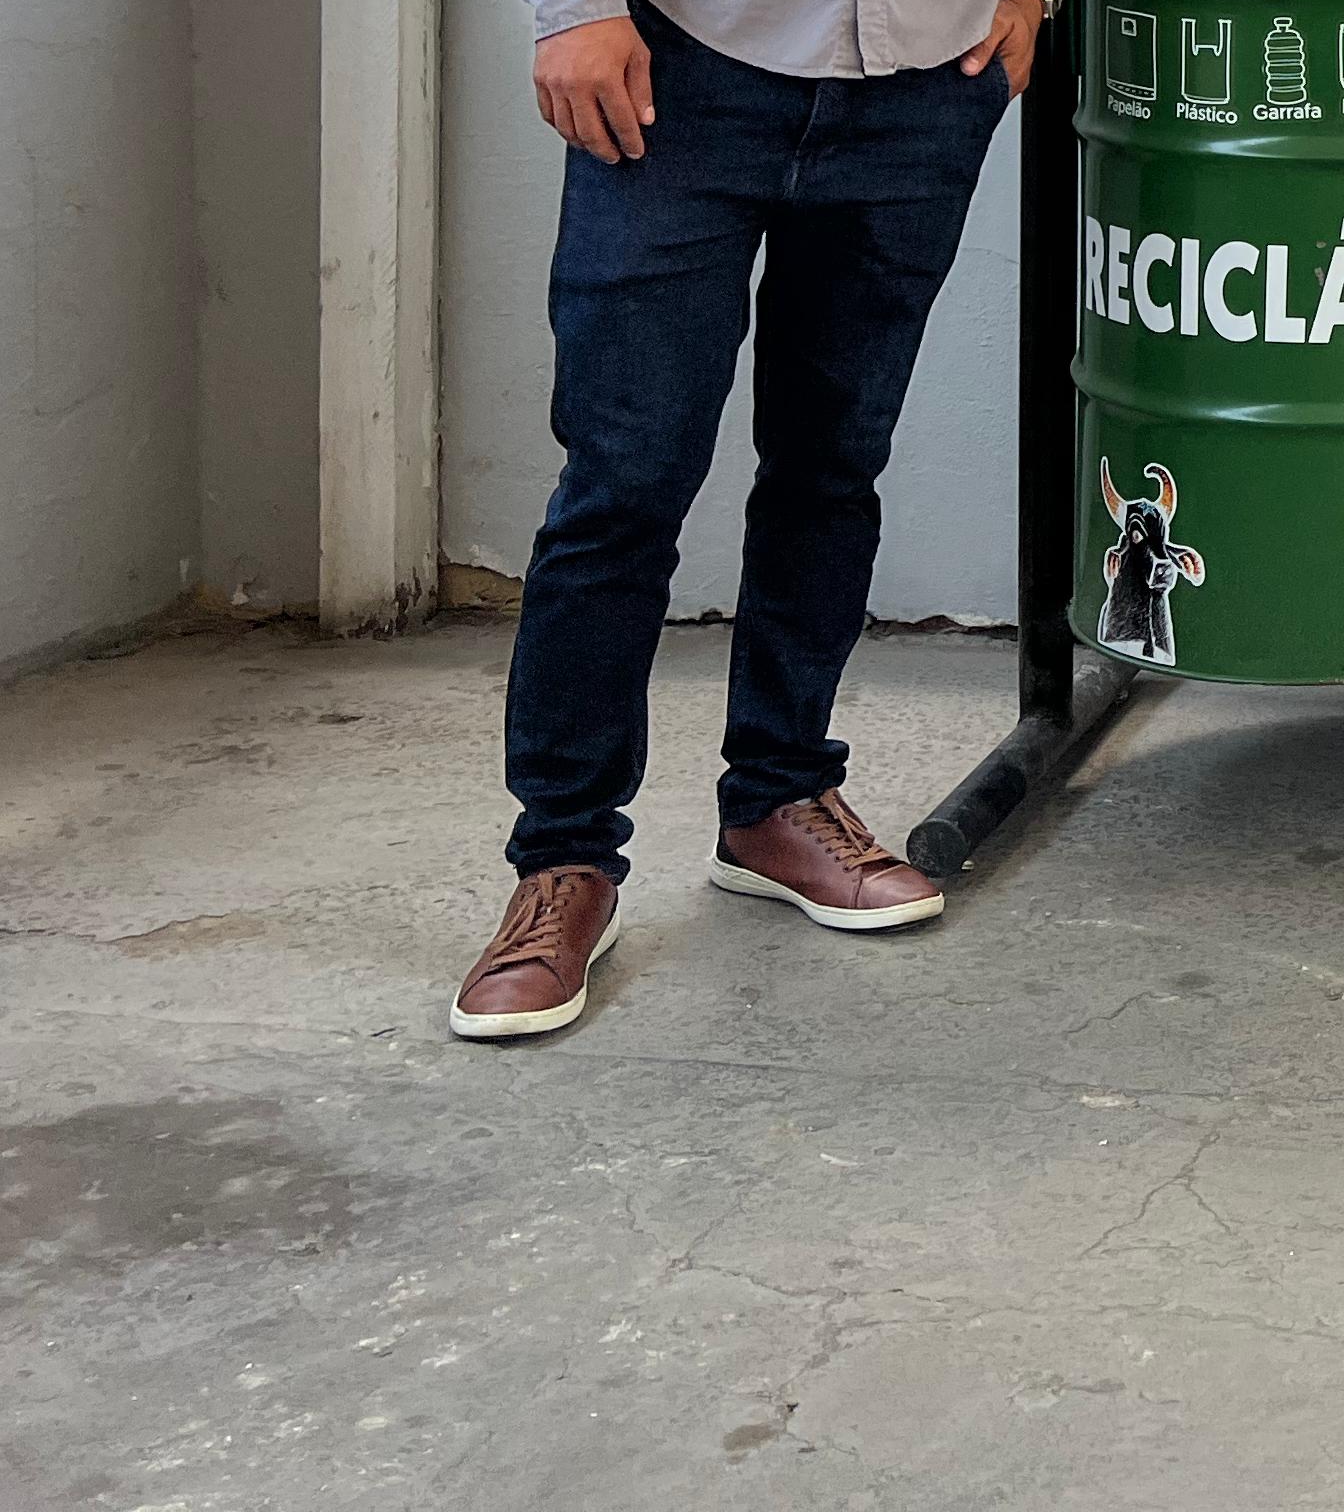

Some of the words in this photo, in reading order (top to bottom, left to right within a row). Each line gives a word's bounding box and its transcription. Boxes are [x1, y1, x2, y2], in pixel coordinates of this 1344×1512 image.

[1107, 94, 1152, 120] Papelão
[1176, 102, 1238, 124] Plástico
[1253, 103, 1322, 121] Garrafa
